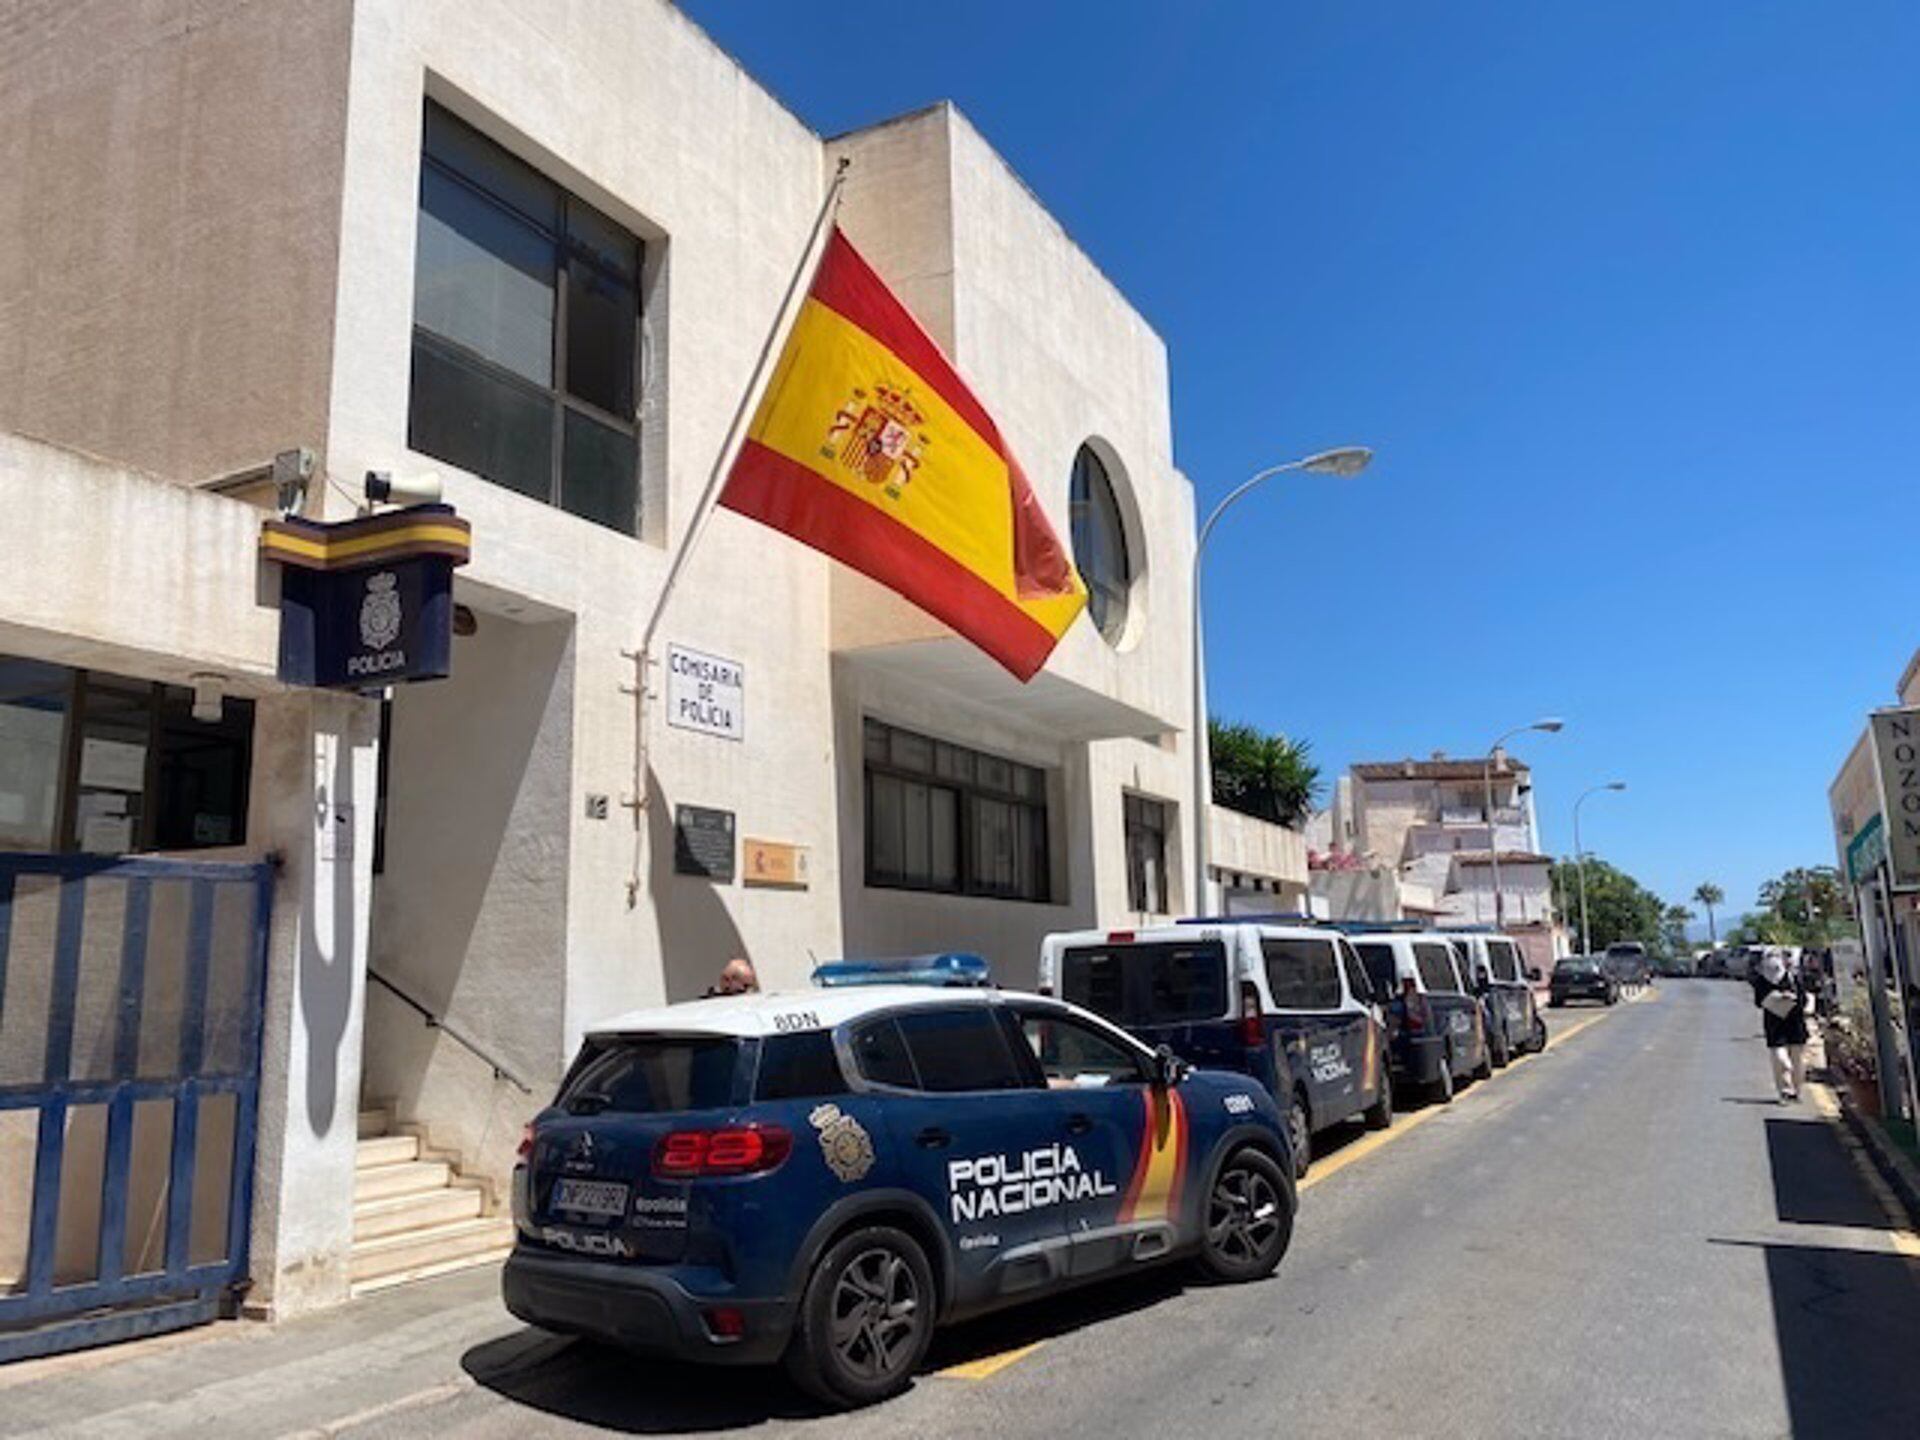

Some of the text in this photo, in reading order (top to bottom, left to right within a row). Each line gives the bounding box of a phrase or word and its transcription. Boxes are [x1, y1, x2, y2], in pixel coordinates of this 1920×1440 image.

[698, 683, 714, 702] DE
[949, 1142, 1081, 1191] POLICÍA
[951, 1170, 1117, 1224] NACIONAL
